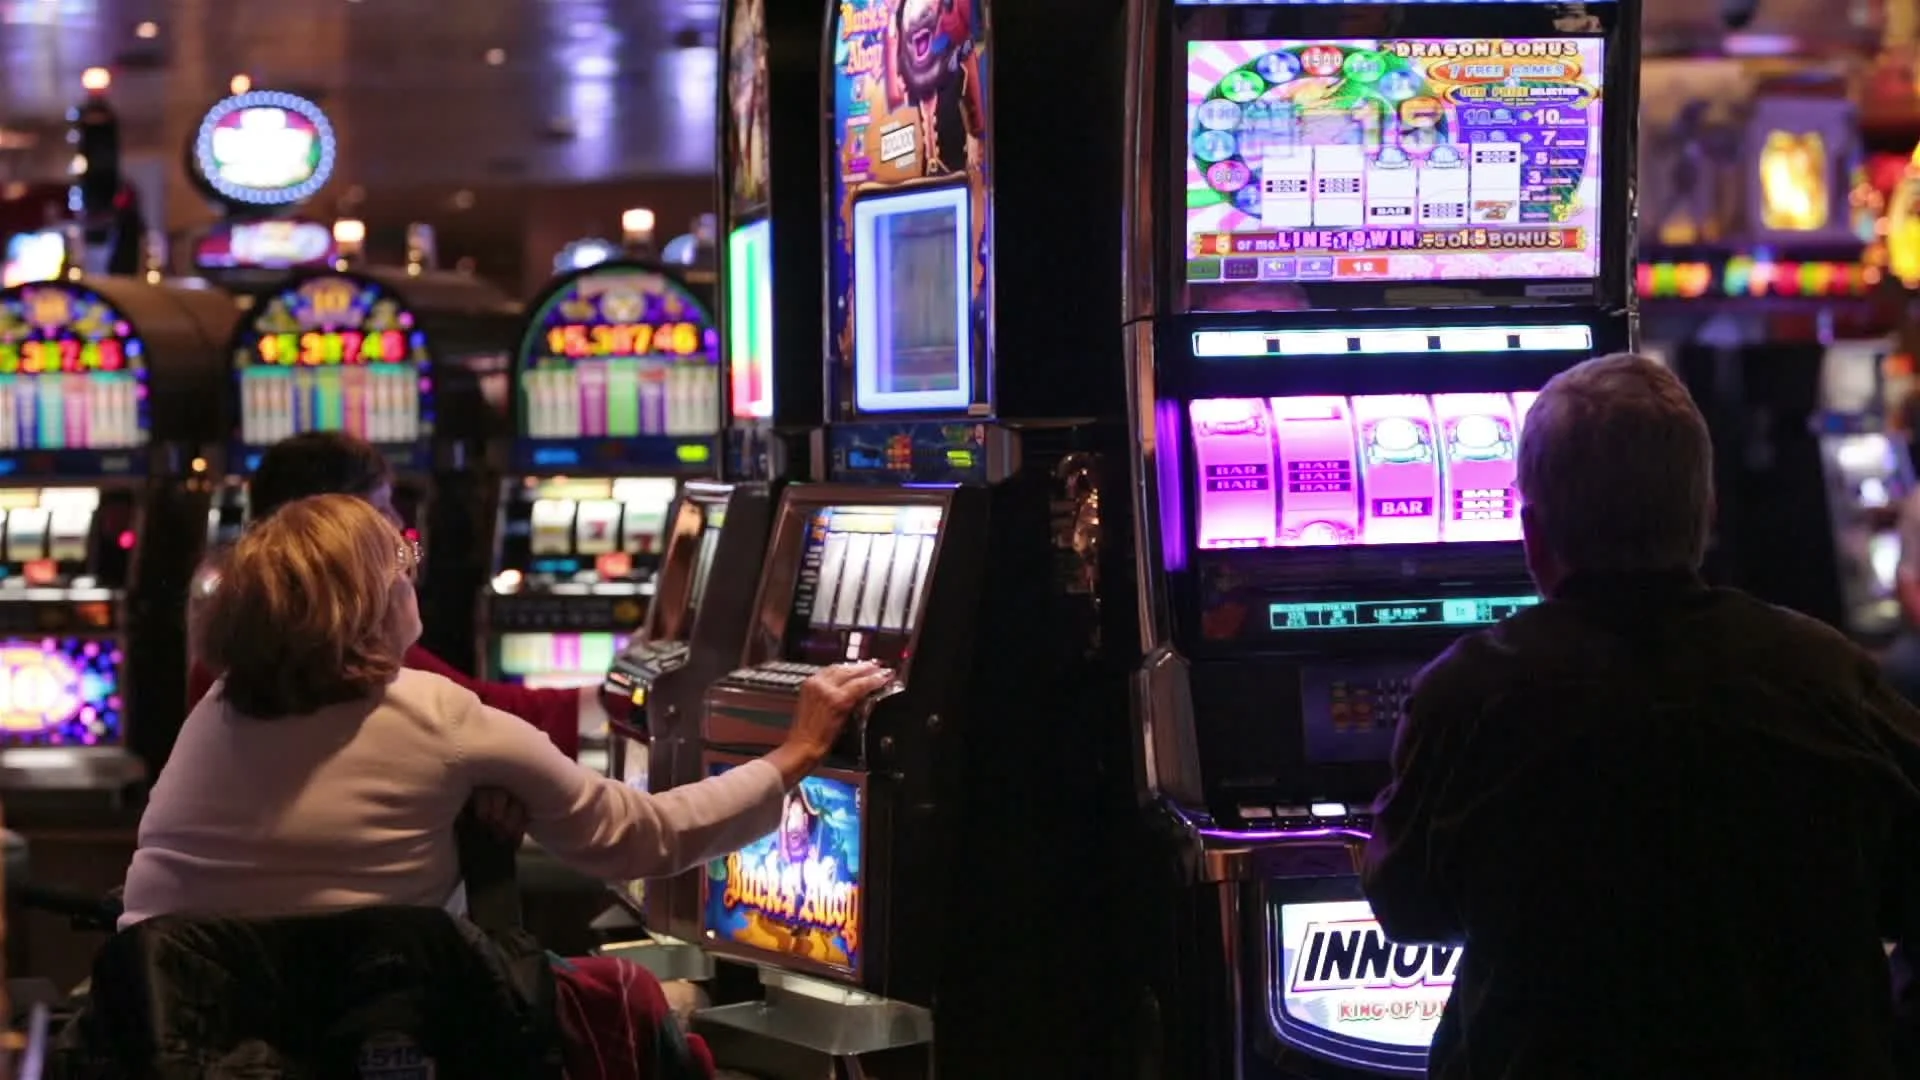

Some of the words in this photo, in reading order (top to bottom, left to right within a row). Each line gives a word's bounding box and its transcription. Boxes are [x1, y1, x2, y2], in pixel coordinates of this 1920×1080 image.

[1396, 42, 1491, 57] DRAGON
[1500, 41, 1578, 57] BONUS
[1465, 64, 1505, 78] FREE
[1509, 64, 1566, 78] GAMES
[1534, 108, 1560, 125] 10
[1541, 130, 1557, 146] 7
[1534, 151, 1549, 165] 5
[1528, 170, 1542, 184] 3
[1376, 206, 1405, 216] BAR
[1237, 239, 1251, 250] or
[1278, 231, 1333, 248] LINE
[1371, 230, 1415, 247] WIN
[1488, 229, 1562, 248] BONUS
[1215, 465, 1257, 476] BAR
[1298, 460, 1339, 469] BAR
[1299, 472, 1340, 481] BAR
[1216, 479, 1259, 489] BAR
[1299, 483, 1341, 491] BAR
[1381, 500, 1423, 515] BAR
[799, 855, 860, 952] Ahoy
